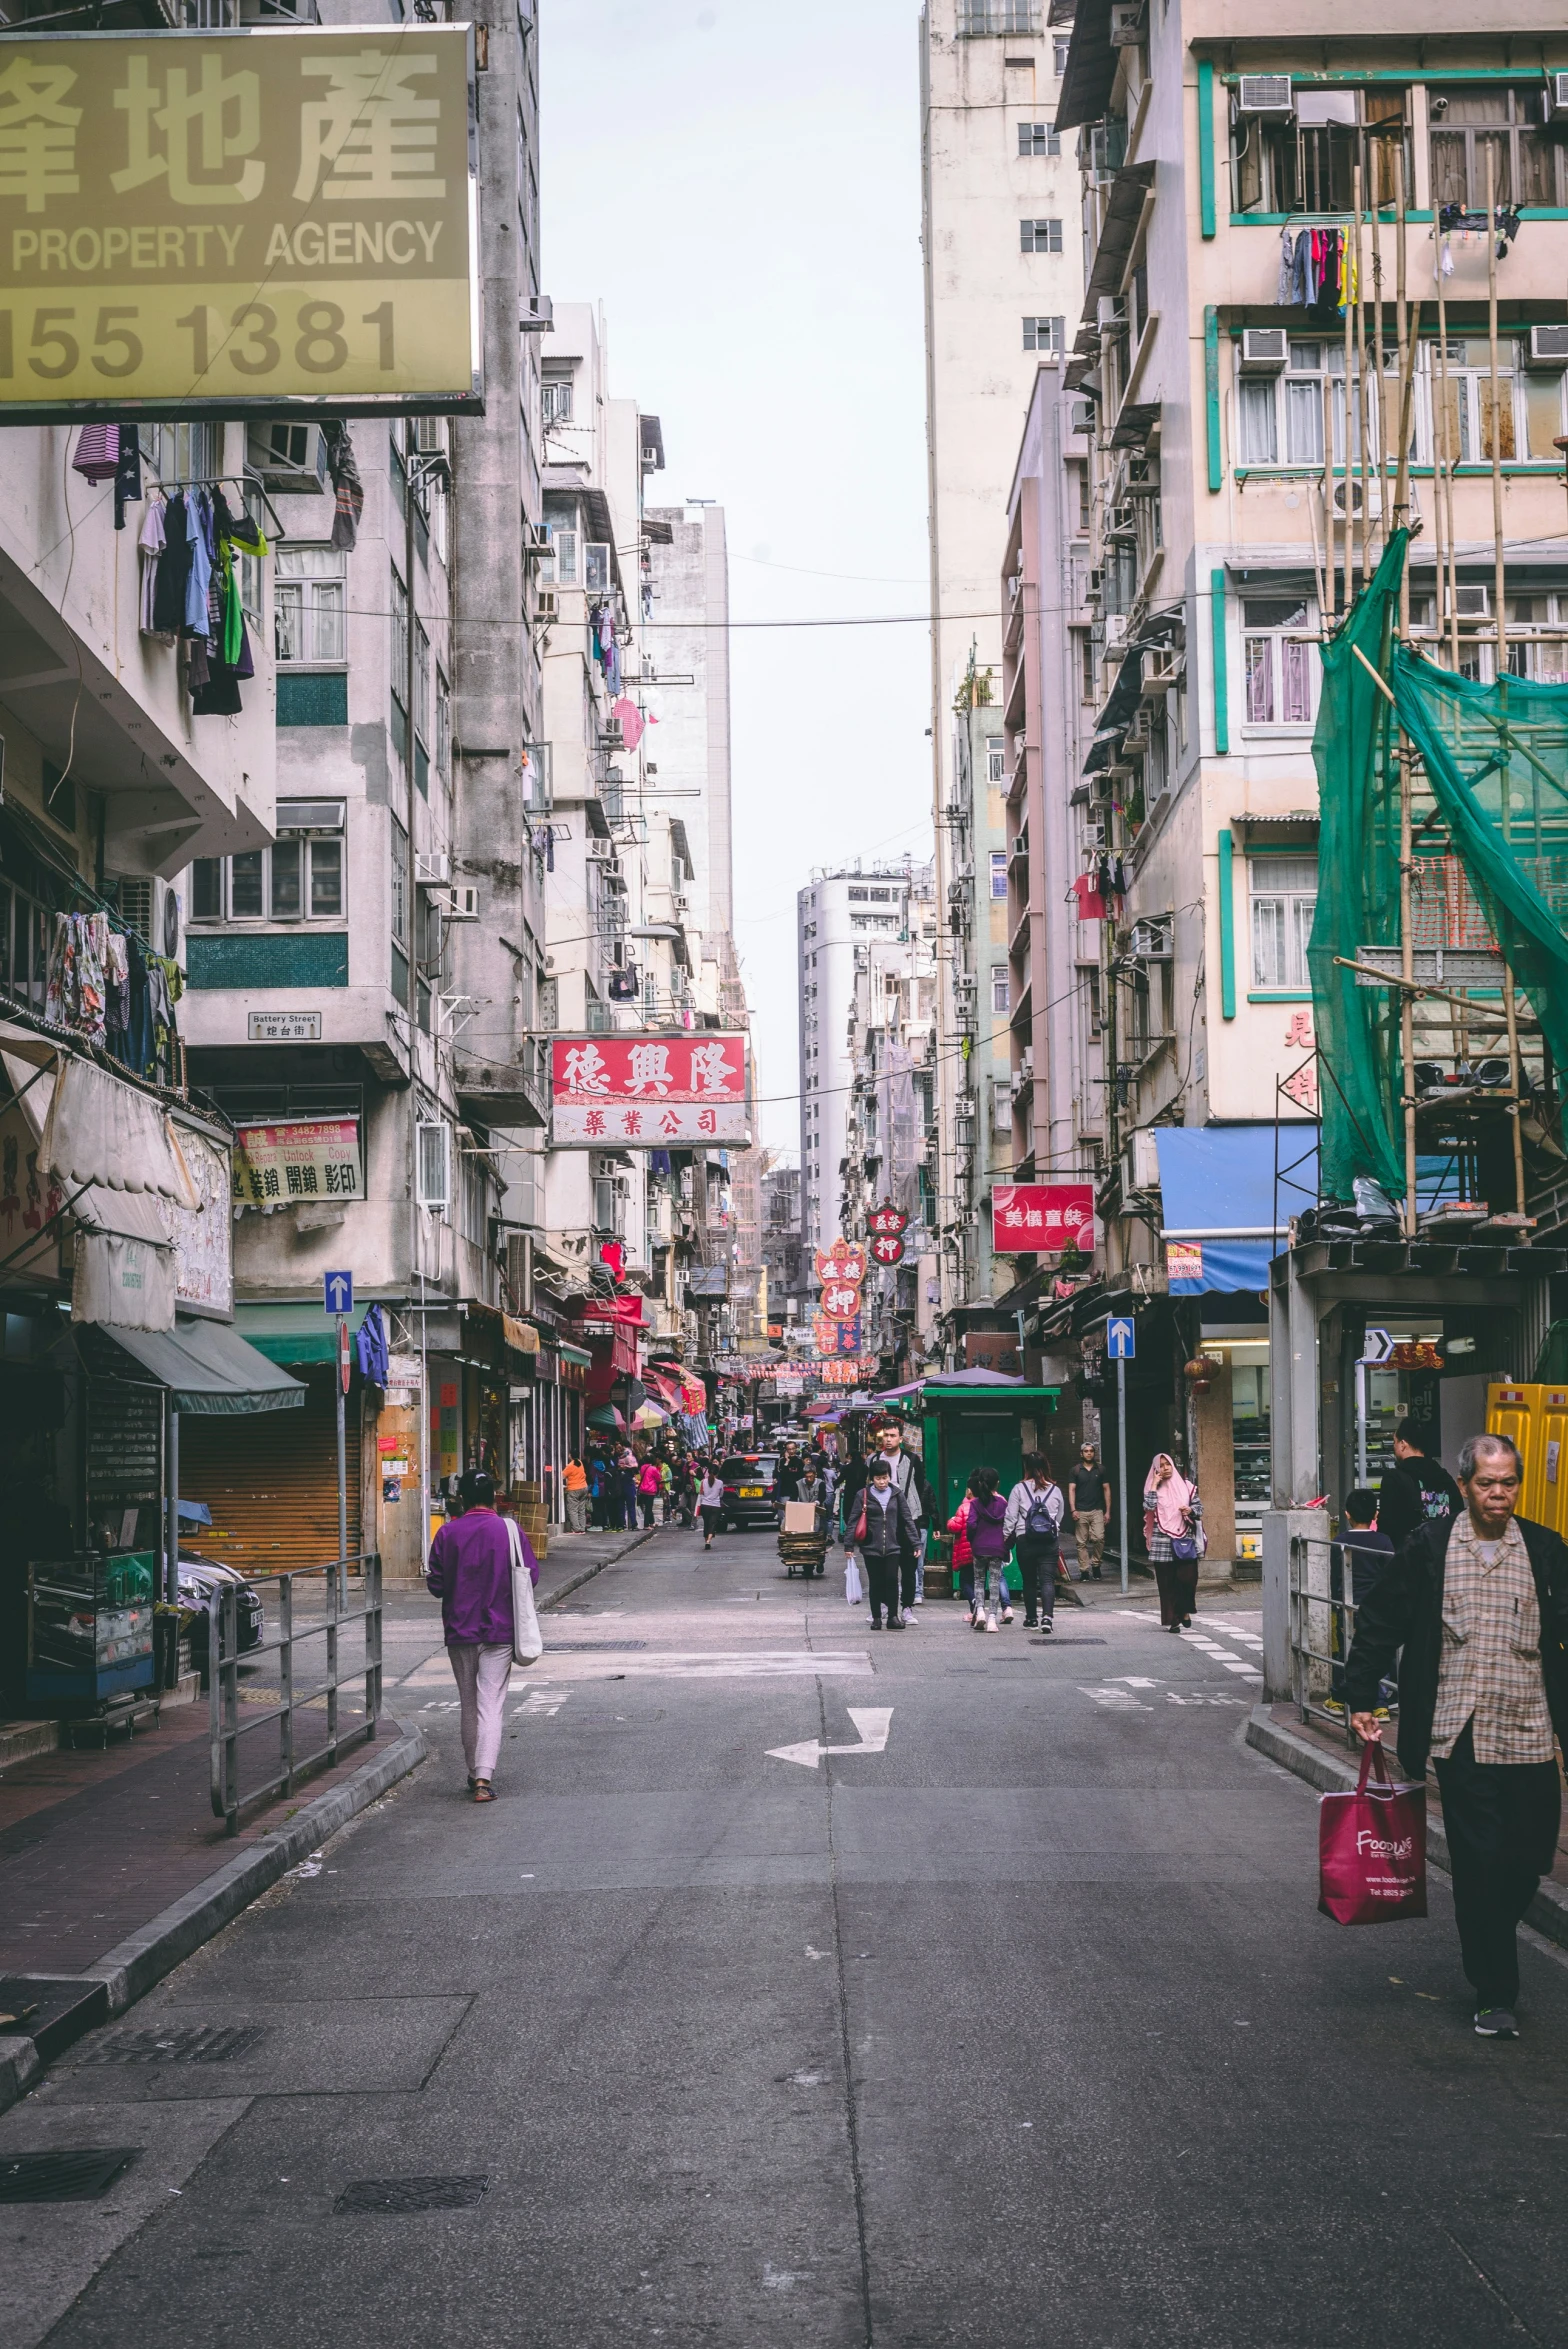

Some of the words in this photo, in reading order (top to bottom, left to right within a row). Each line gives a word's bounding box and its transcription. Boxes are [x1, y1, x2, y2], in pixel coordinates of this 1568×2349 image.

[12, 226, 244, 271] PROPERTY
[264, 221, 443, 266] AGENCY
[176, 301, 395, 375] 1381
[253, 1015, 286, 1023] Battery
[267, 1026, 304, 1036] 炮台街
[562, 1042, 738, 1097] 德興隆
[292, 1126, 318, 1135] 3482
[319, 1124, 341, 1134] 7898
[583, 1108, 716, 1136] 藥業公司
[283, 1148, 314, 1162] Unlock
[329, 1147, 351, 1161] Copy
[249, 1168, 280, 1199] 裝鎖
[286, 1165, 318, 1194] 開鎖
[325, 1163, 356, 1193] 影印
[1005, 1209, 1082, 1227] 美儀童裝
[876, 1237, 898, 1260] 押
[826, 1286, 855, 1315] 押
